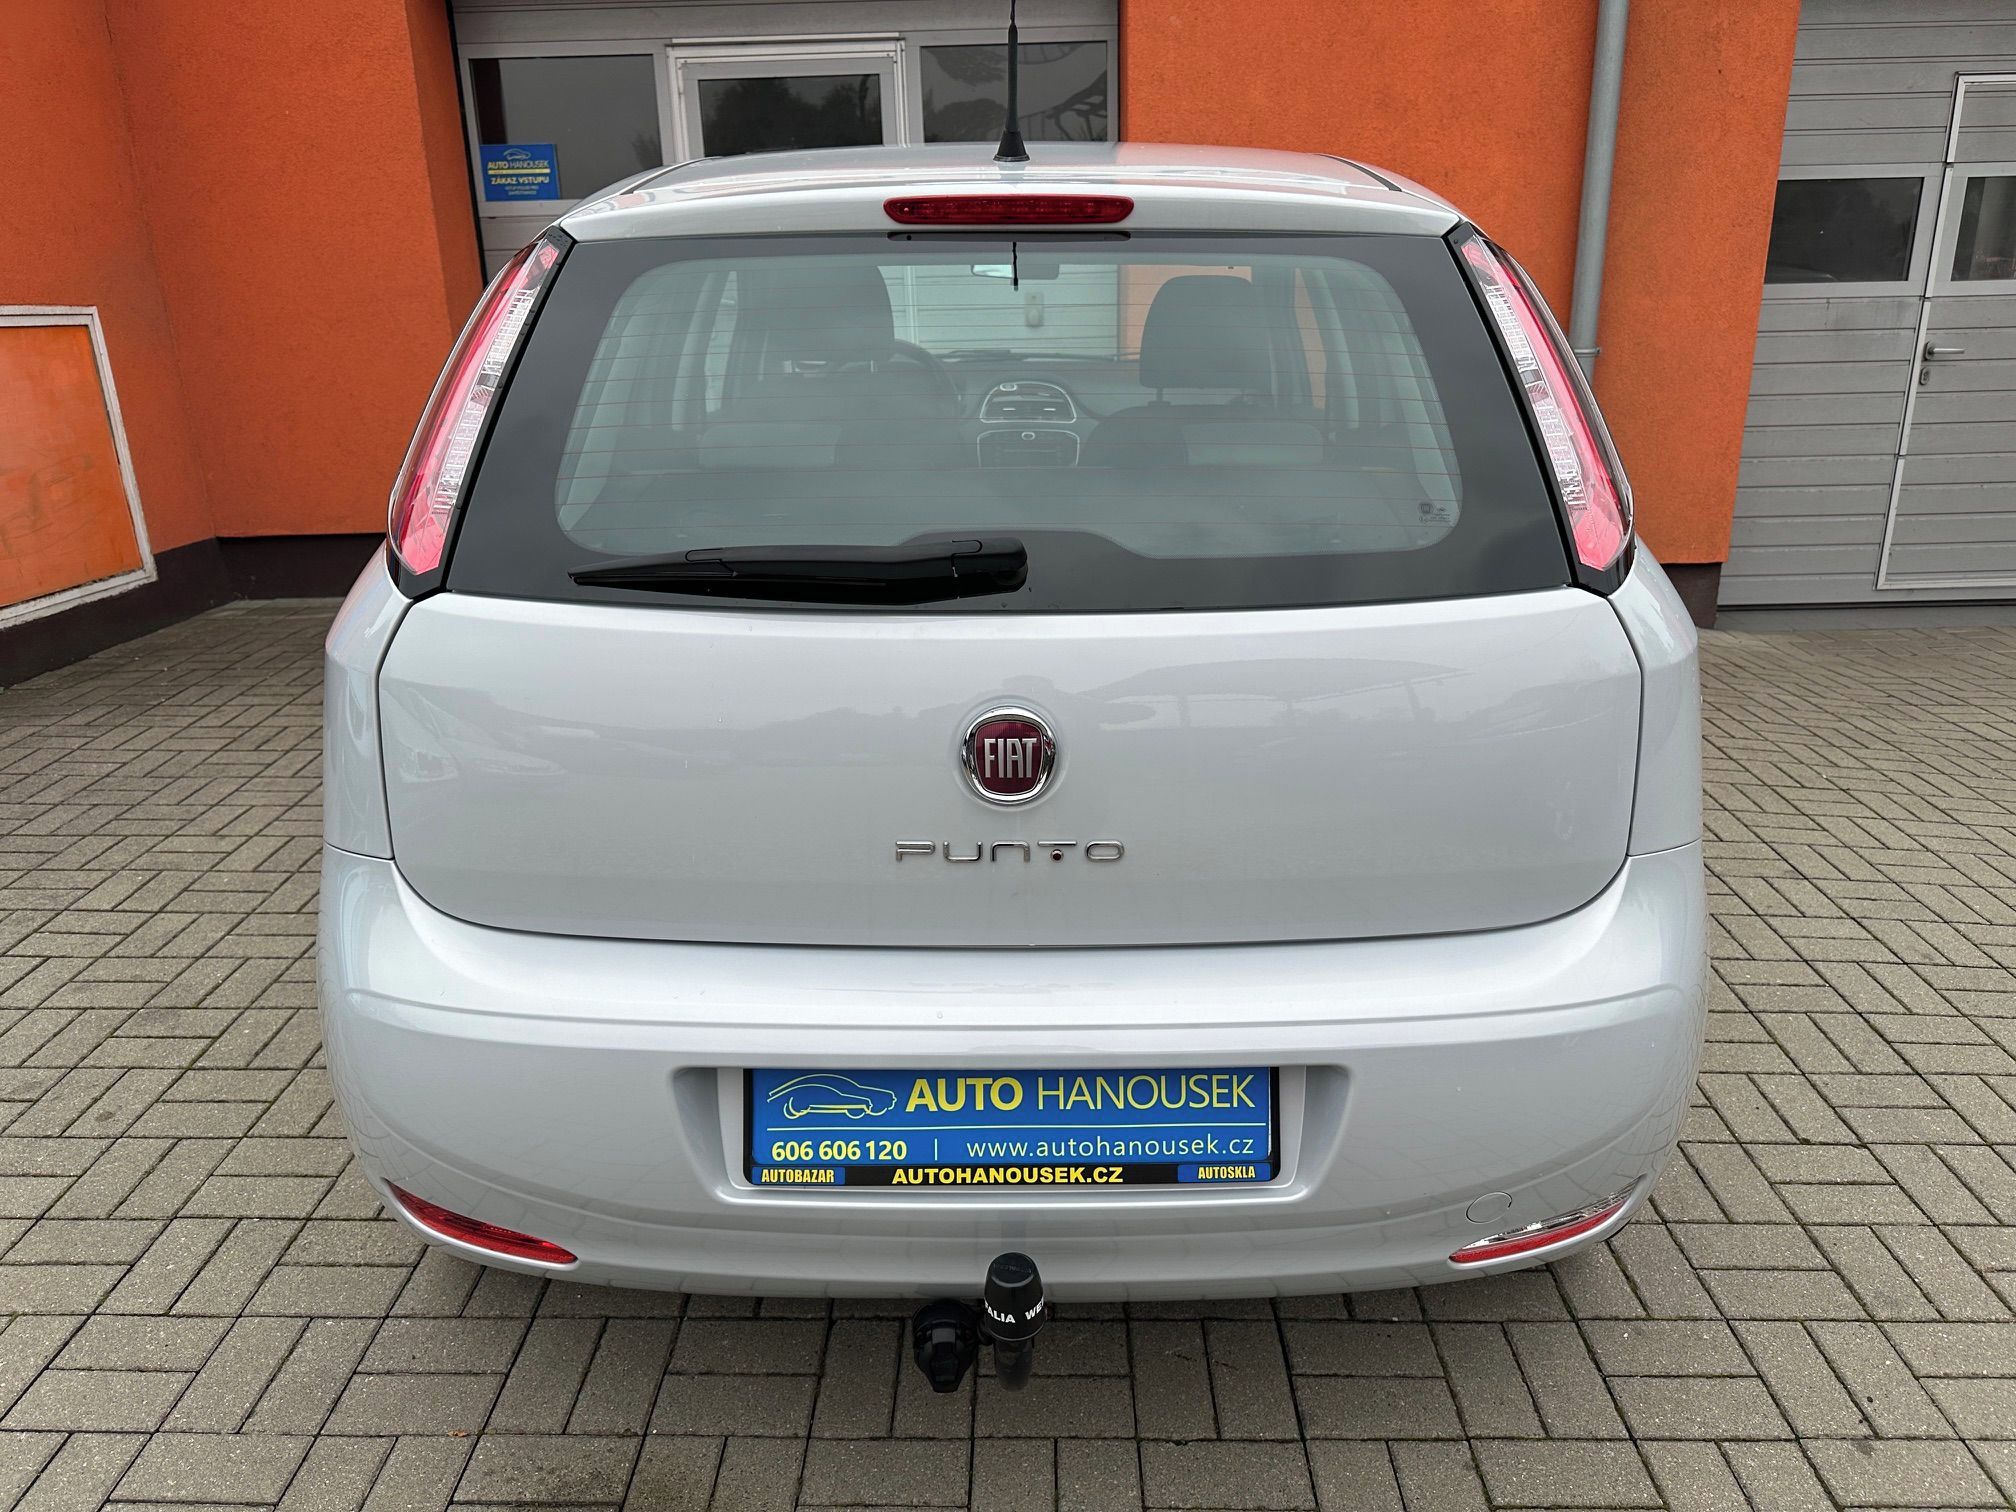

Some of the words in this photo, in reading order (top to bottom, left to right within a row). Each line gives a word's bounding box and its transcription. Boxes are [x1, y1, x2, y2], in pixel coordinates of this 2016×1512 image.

[487, 161, 509, 169] AUTO
[984, 738, 1037, 778] FIAT
[895, 840, 1125, 863] PUNTO
[905, 1077, 1024, 1113] AUTO
[1037, 1074, 1256, 1110] HANOUSEK
[771, 1141, 814, 1161] 606
[818, 1140, 861, 1160] 606
[865, 1140, 907, 1160] 120
[966, 1134, 1254, 1157] www.autohanousek.cz
[761, 1169, 835, 1183] AUTOBAZAR
[891, 1168, 1124, 1185] AUTOHANOUSEK.CZ
[1197, 1166, 1256, 1179] AUTOSKLA
